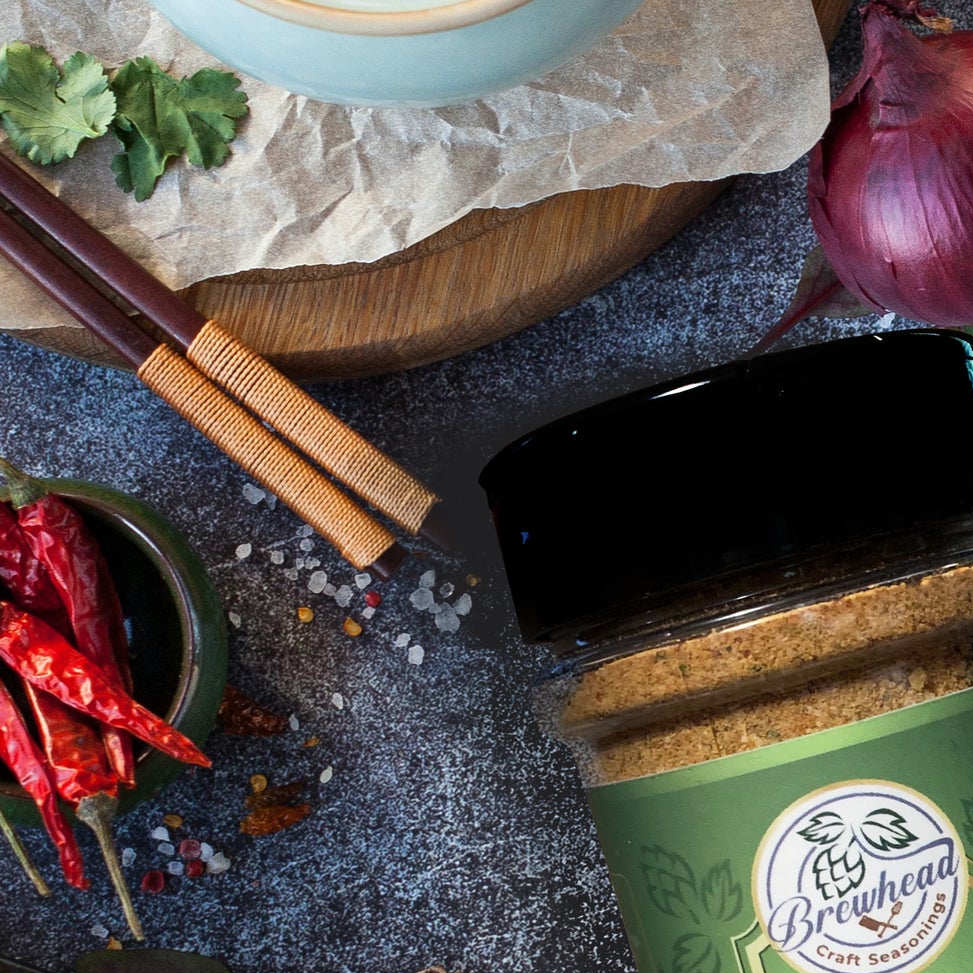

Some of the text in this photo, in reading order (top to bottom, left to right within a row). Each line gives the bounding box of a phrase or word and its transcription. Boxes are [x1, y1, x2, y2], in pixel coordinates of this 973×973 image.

[768, 838, 960, 952] Brewhead
[816, 892, 946, 966] Craft Seasonings
